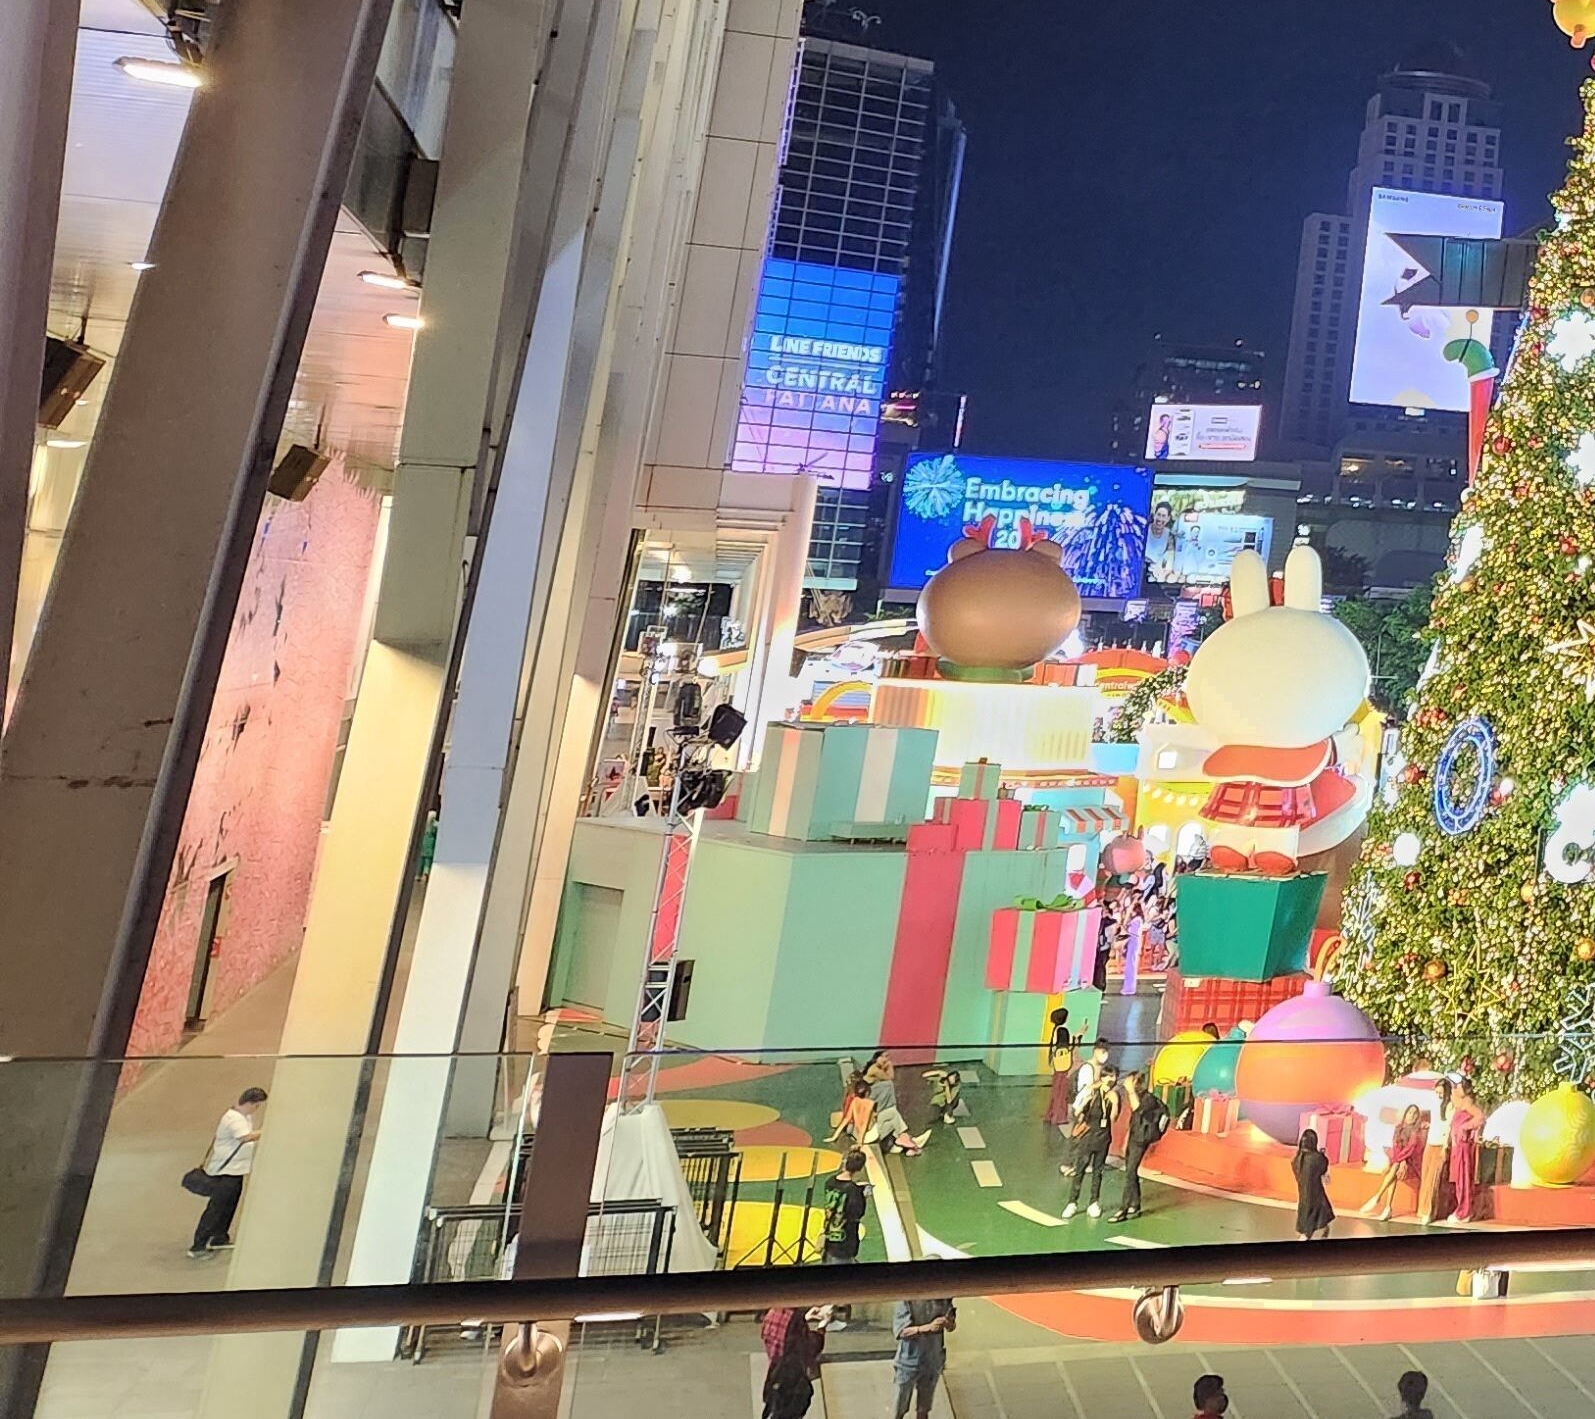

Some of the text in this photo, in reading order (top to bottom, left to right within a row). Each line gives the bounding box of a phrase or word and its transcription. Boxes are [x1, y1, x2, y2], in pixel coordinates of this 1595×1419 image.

[770, 334, 882, 363] LINE FRIENDS
[766, 365, 877, 395] CENTRAL
[964, 476, 1090, 510] Embracing
